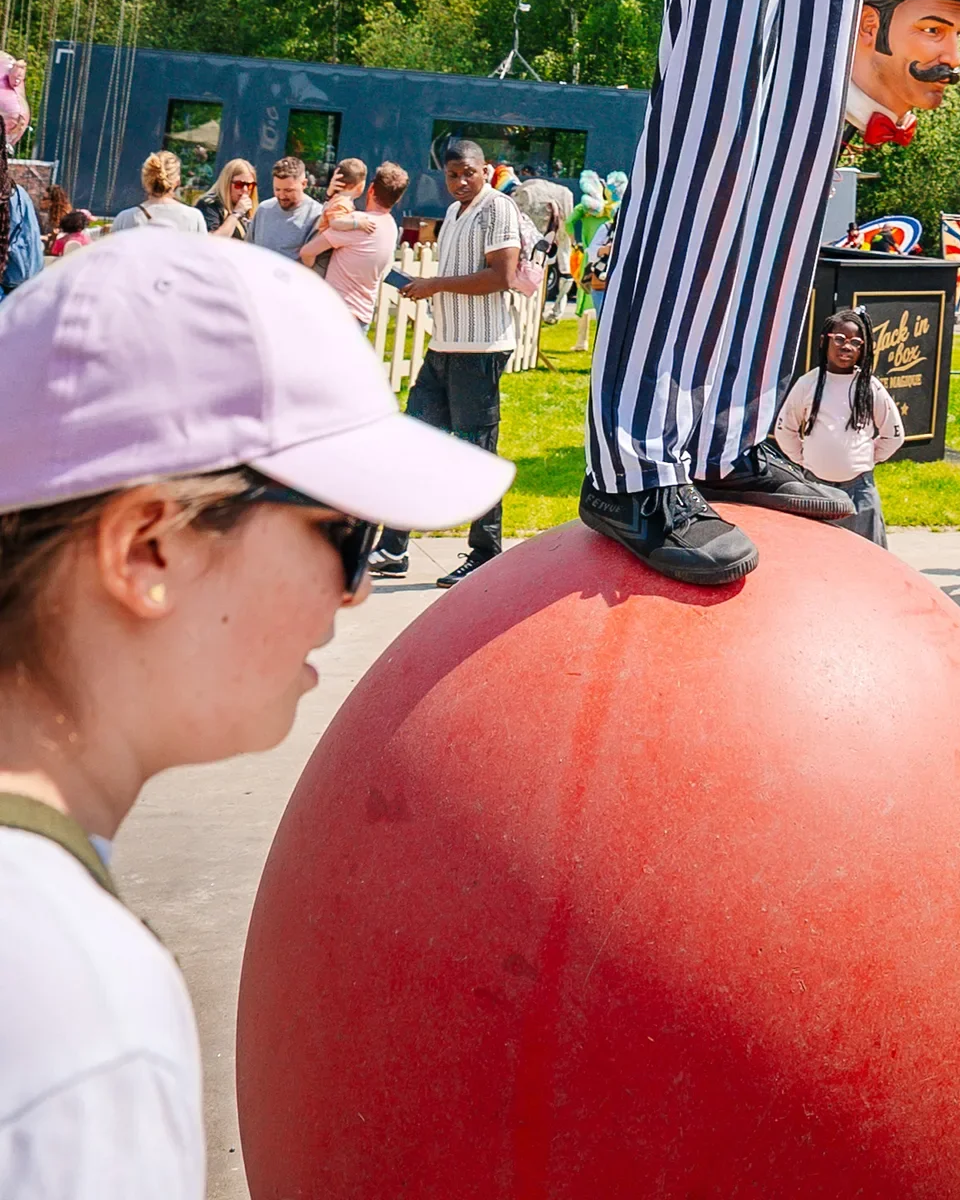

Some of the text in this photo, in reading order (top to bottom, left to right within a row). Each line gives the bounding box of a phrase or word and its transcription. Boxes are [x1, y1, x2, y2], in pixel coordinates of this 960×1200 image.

[872, 309, 930, 374] Jack in
[888, 342, 921, 367] a box
